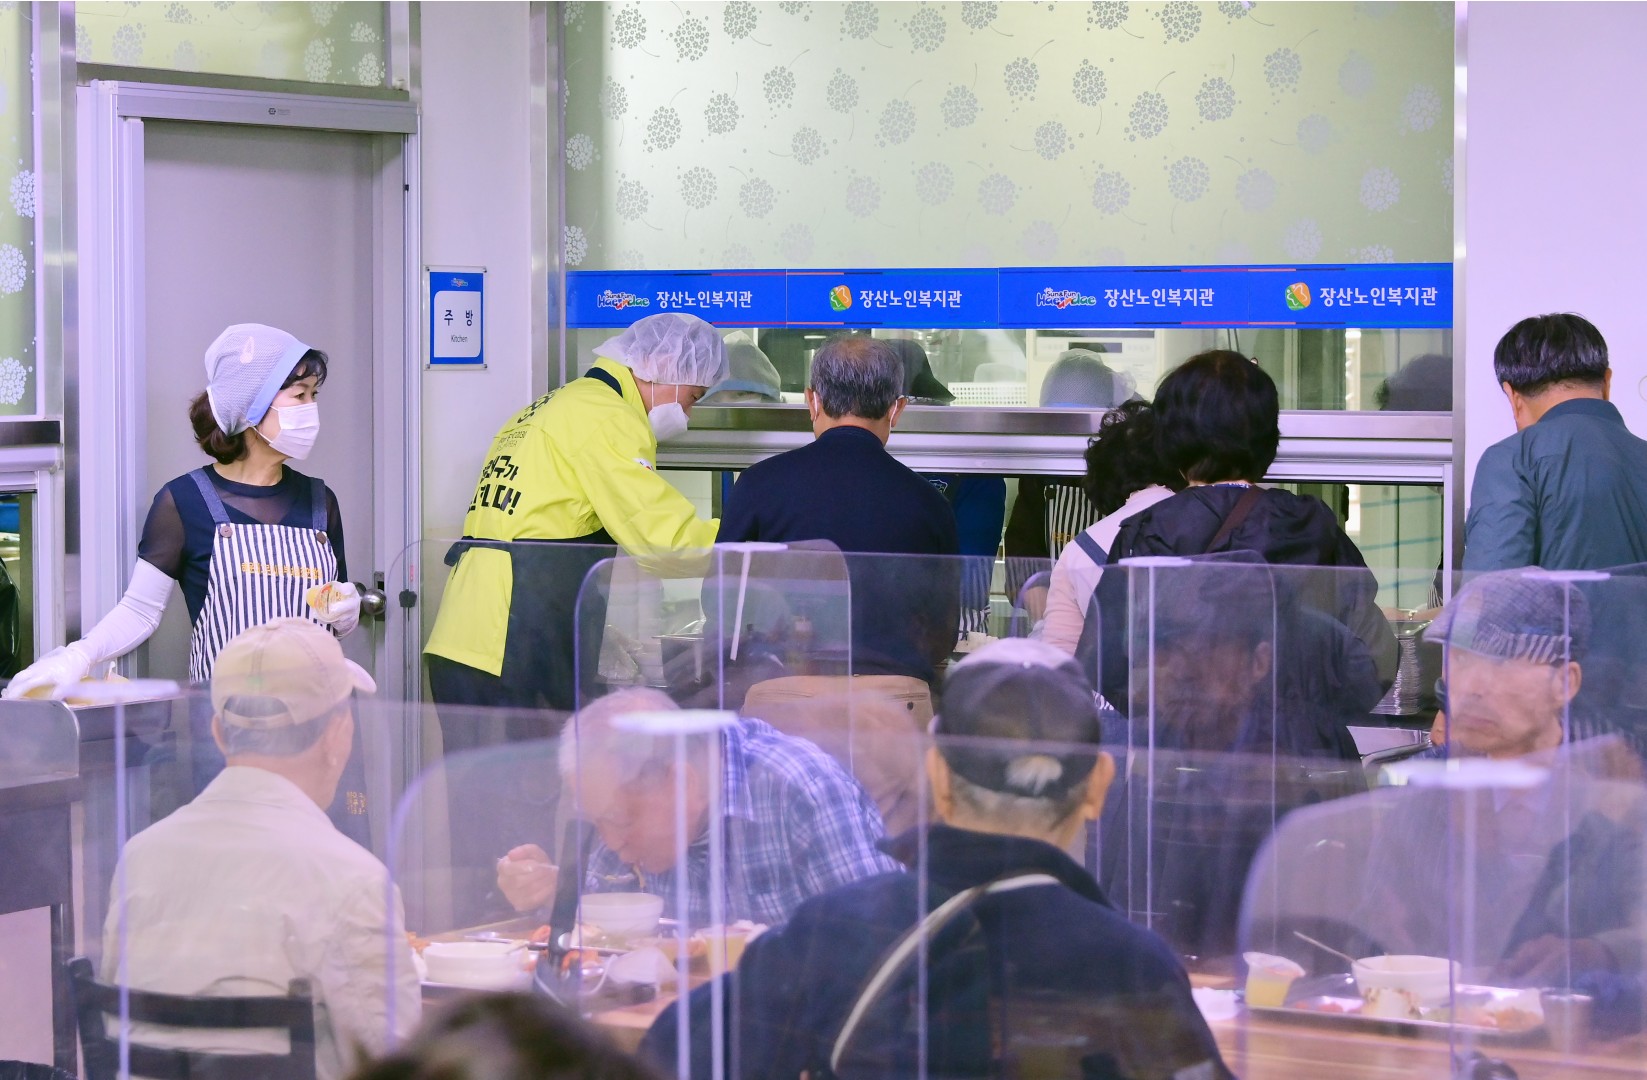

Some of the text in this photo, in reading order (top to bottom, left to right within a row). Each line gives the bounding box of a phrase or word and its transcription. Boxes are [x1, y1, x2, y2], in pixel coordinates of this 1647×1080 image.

[656, 289, 753, 308] 장산노인복지관
[859, 289, 963, 309] 장산노인복지관
[1104, 287, 1215, 308] 장산노인복지관
[1320, 286, 1438, 308] 장산노인복지관
[450, 335, 468, 343] Kitchen
